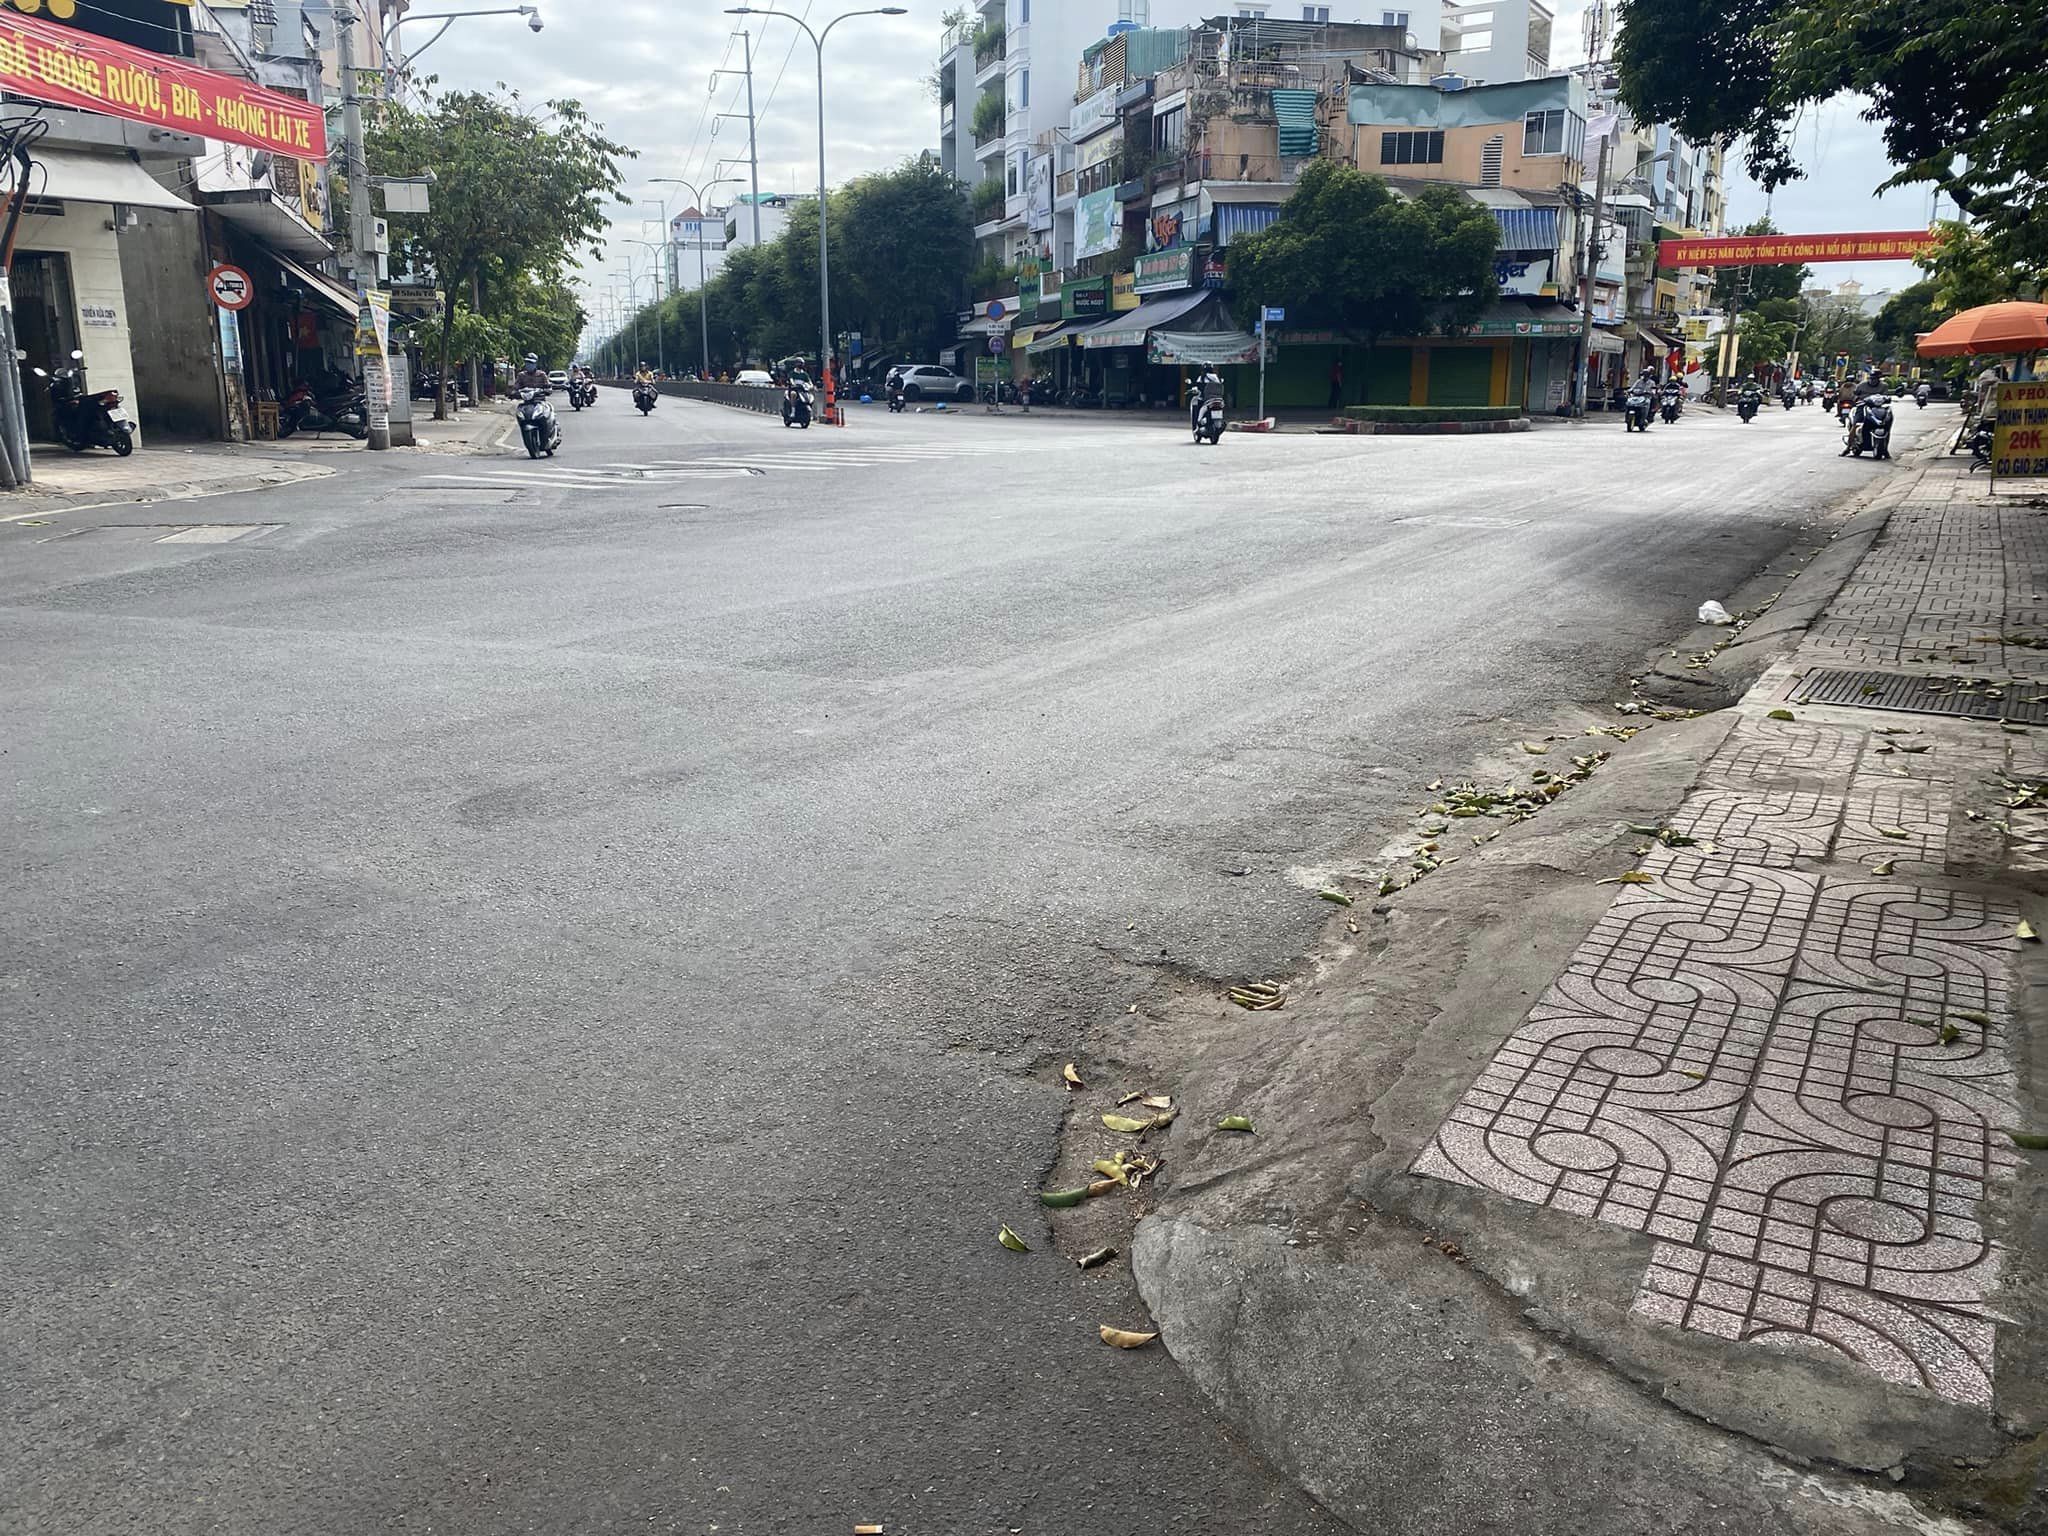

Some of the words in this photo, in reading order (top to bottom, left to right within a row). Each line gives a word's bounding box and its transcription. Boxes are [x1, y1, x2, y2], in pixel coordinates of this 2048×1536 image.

[106, 62, 167, 119] RƯỢU,
[171, 83, 201, 121] BIA
[215, 95, 267, 139] KHÔNG
[270, 107, 292, 144] LÁI
[294, 118, 311, 149] XE
[1688, 247, 1707, 261] NIỆM
[1708, 248, 1717, 260] 55
[1718, 246, 1734, 260] NĂM
[1735, 244, 1755, 260] CUỘC
[1756, 240, 1775, 258] TỔNG
[1776, 241, 1793, 257] TIẾN
[1794, 243, 1815, 257] CÔNG
[1815, 241, 1825, 256] VÀ
[2009, 429, 2043, 450] 20K
[1997, 453, 2010, 474] CÓ
